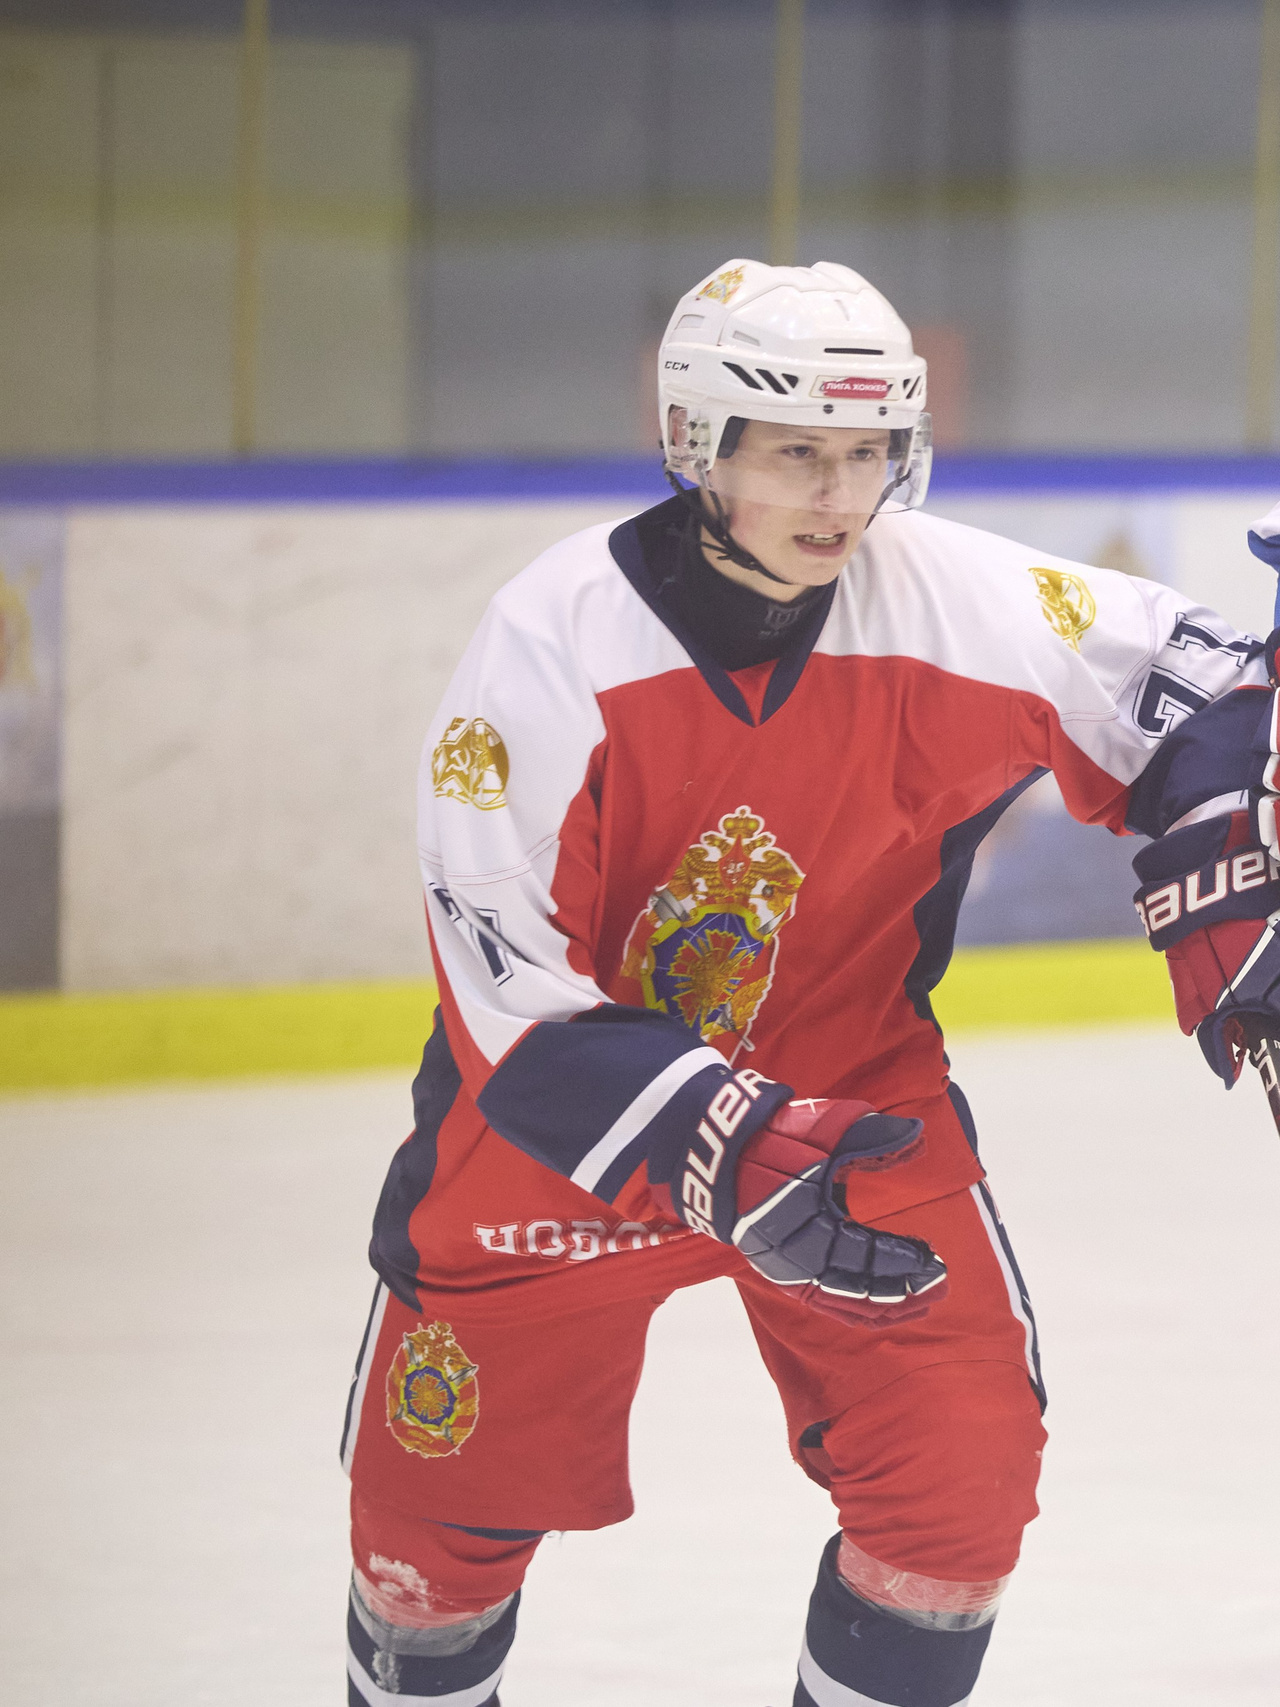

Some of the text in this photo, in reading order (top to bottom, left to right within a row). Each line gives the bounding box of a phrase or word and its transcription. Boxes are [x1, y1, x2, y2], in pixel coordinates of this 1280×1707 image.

[664, 360, 690, 372] CCM
[825, 382, 888, 393] ЛИГА ХОККЕЯ
